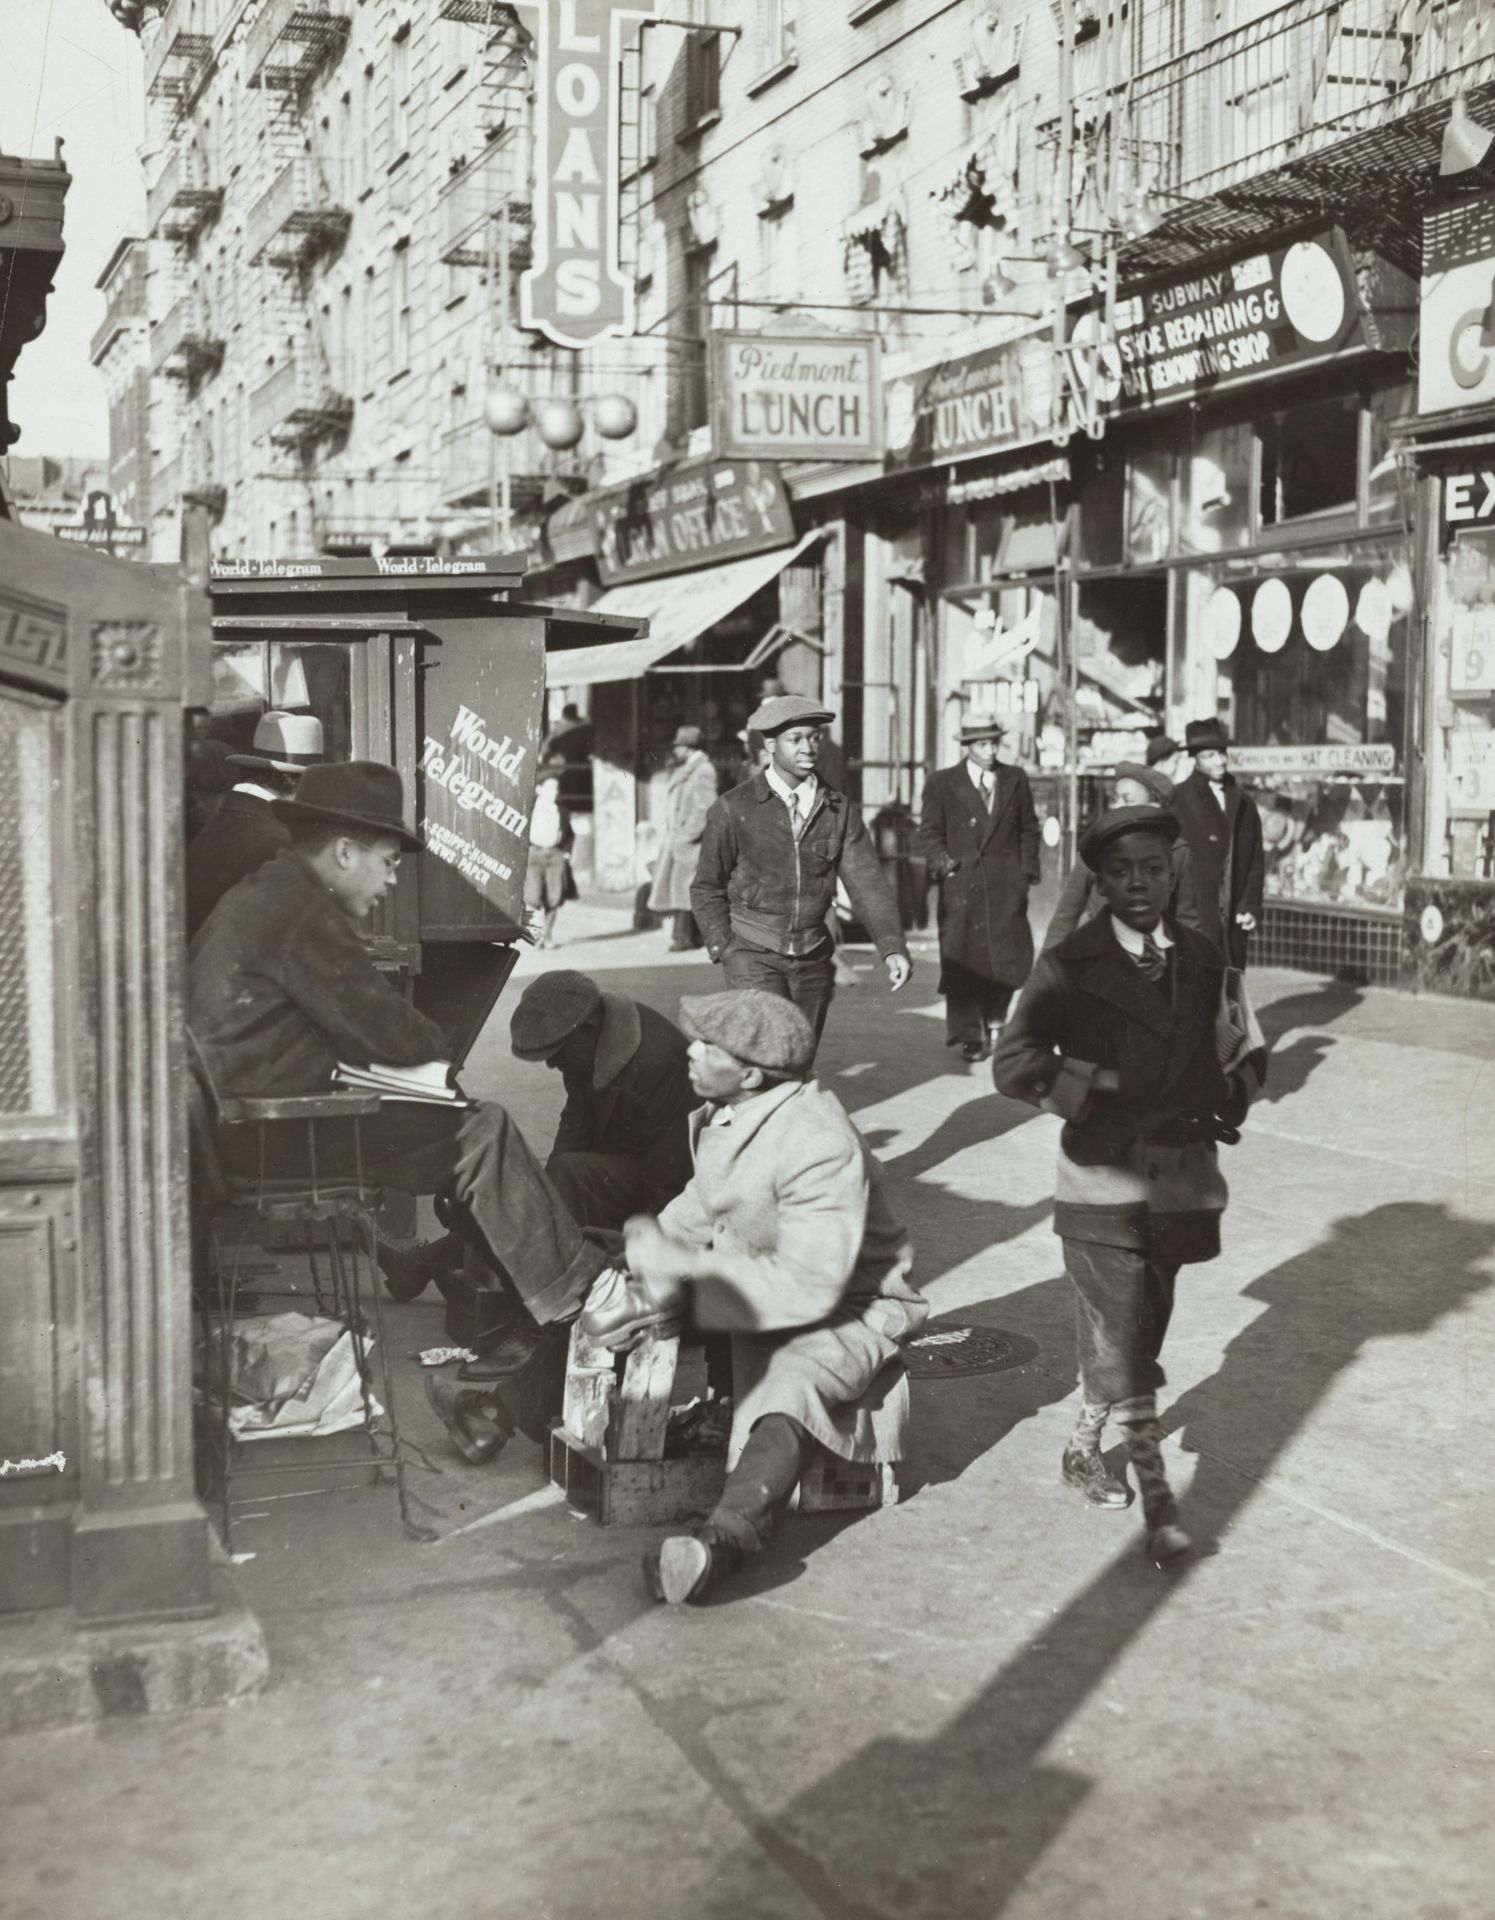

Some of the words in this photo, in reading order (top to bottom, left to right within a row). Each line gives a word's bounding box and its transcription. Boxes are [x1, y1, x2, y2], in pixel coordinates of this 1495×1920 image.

[553, 0, 601, 316] LOANS
[1152, 273, 1224, 314] SUBWAY
[1119, 325, 1166, 362] SHOE
[1163, 294, 1263, 350] REPAIRING
[1263, 288, 1280, 320] &
[734, 347, 862, 383] Piedmont
[1227, 331, 1270, 368] SHOP
[740, 391, 860, 437] LUNCH
[450, 704, 527, 780] World
[1301, 750, 1322, 768] HAT
[1327, 749, 1392, 768] CLEANING
[423, 735, 529, 838] Telegram
